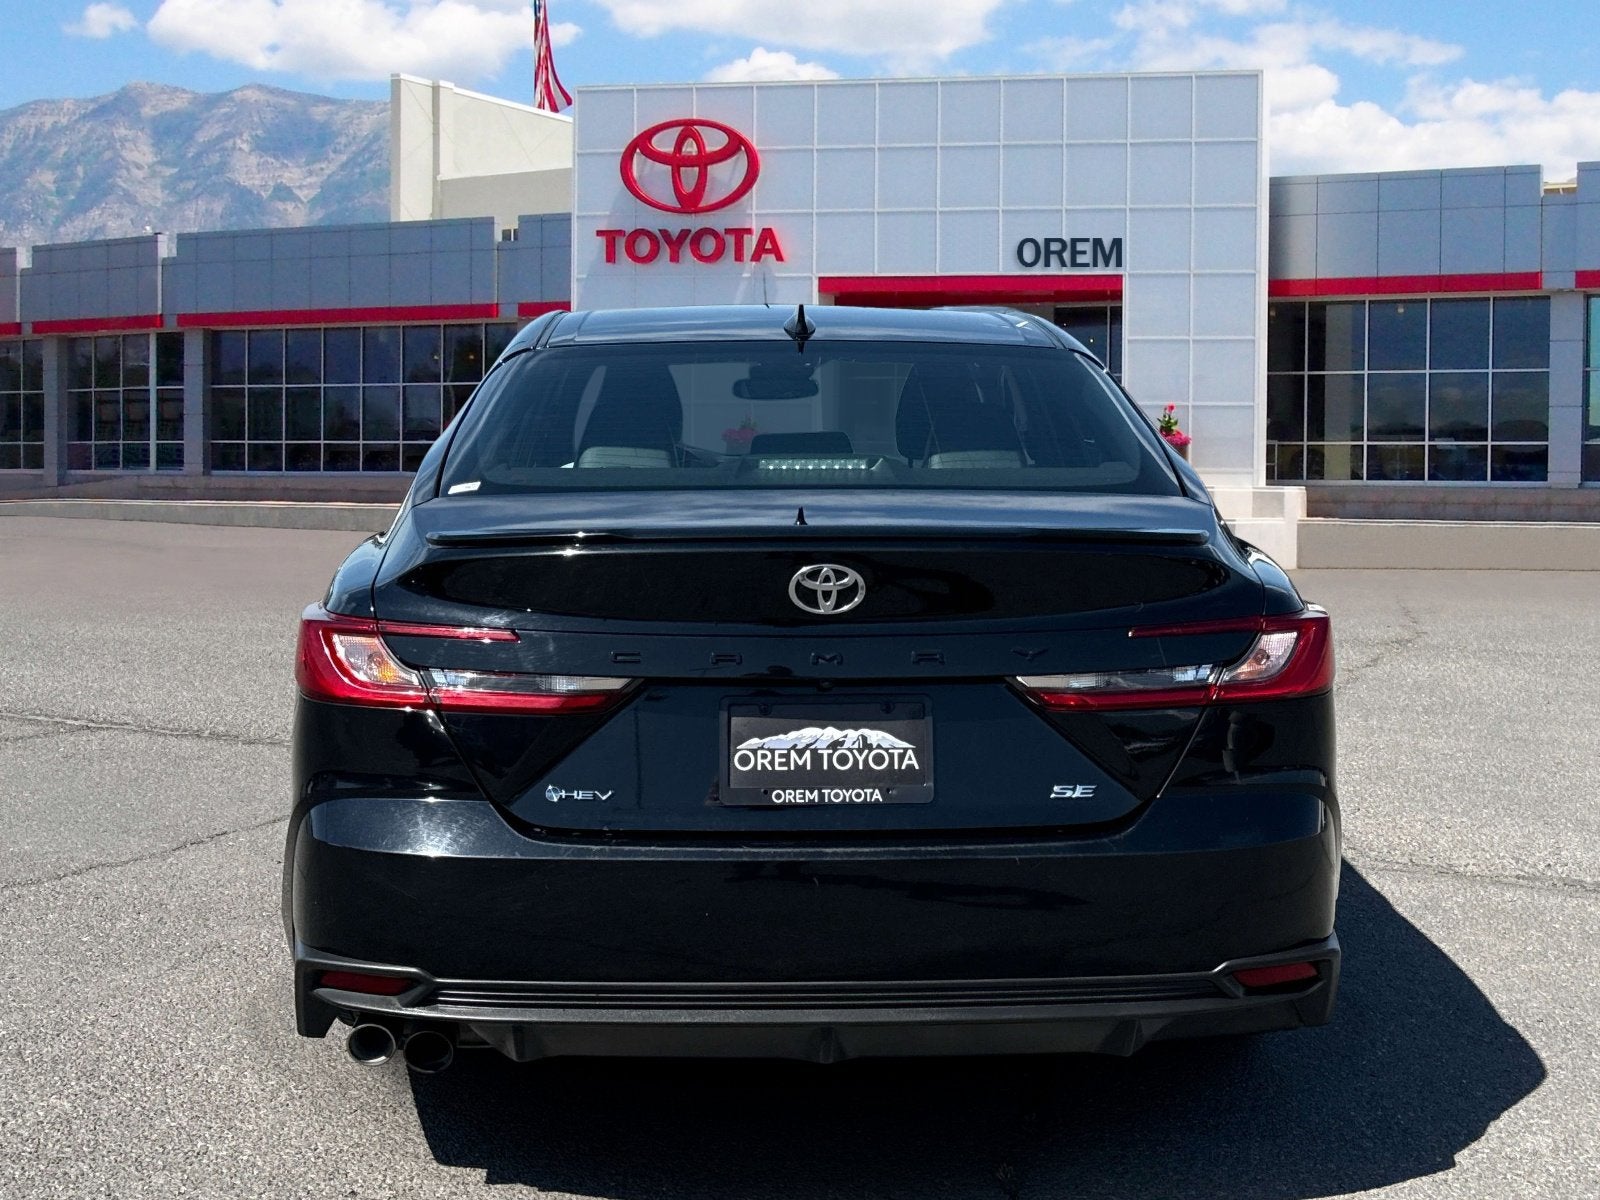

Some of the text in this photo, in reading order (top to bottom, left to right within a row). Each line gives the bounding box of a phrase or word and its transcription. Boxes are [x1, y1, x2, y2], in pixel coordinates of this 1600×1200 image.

[596, 227, 786, 264] TOYOTA
[1016, 237, 1123, 268] OREM
[610, 649, 1050, 666] CAMRY
[734, 749, 920, 771] OREM TOYOTA
[560, 789, 613, 800] HEV
[771, 788, 883, 804] OREM TOYOTA
[1049, 784, 1097, 799] SE
